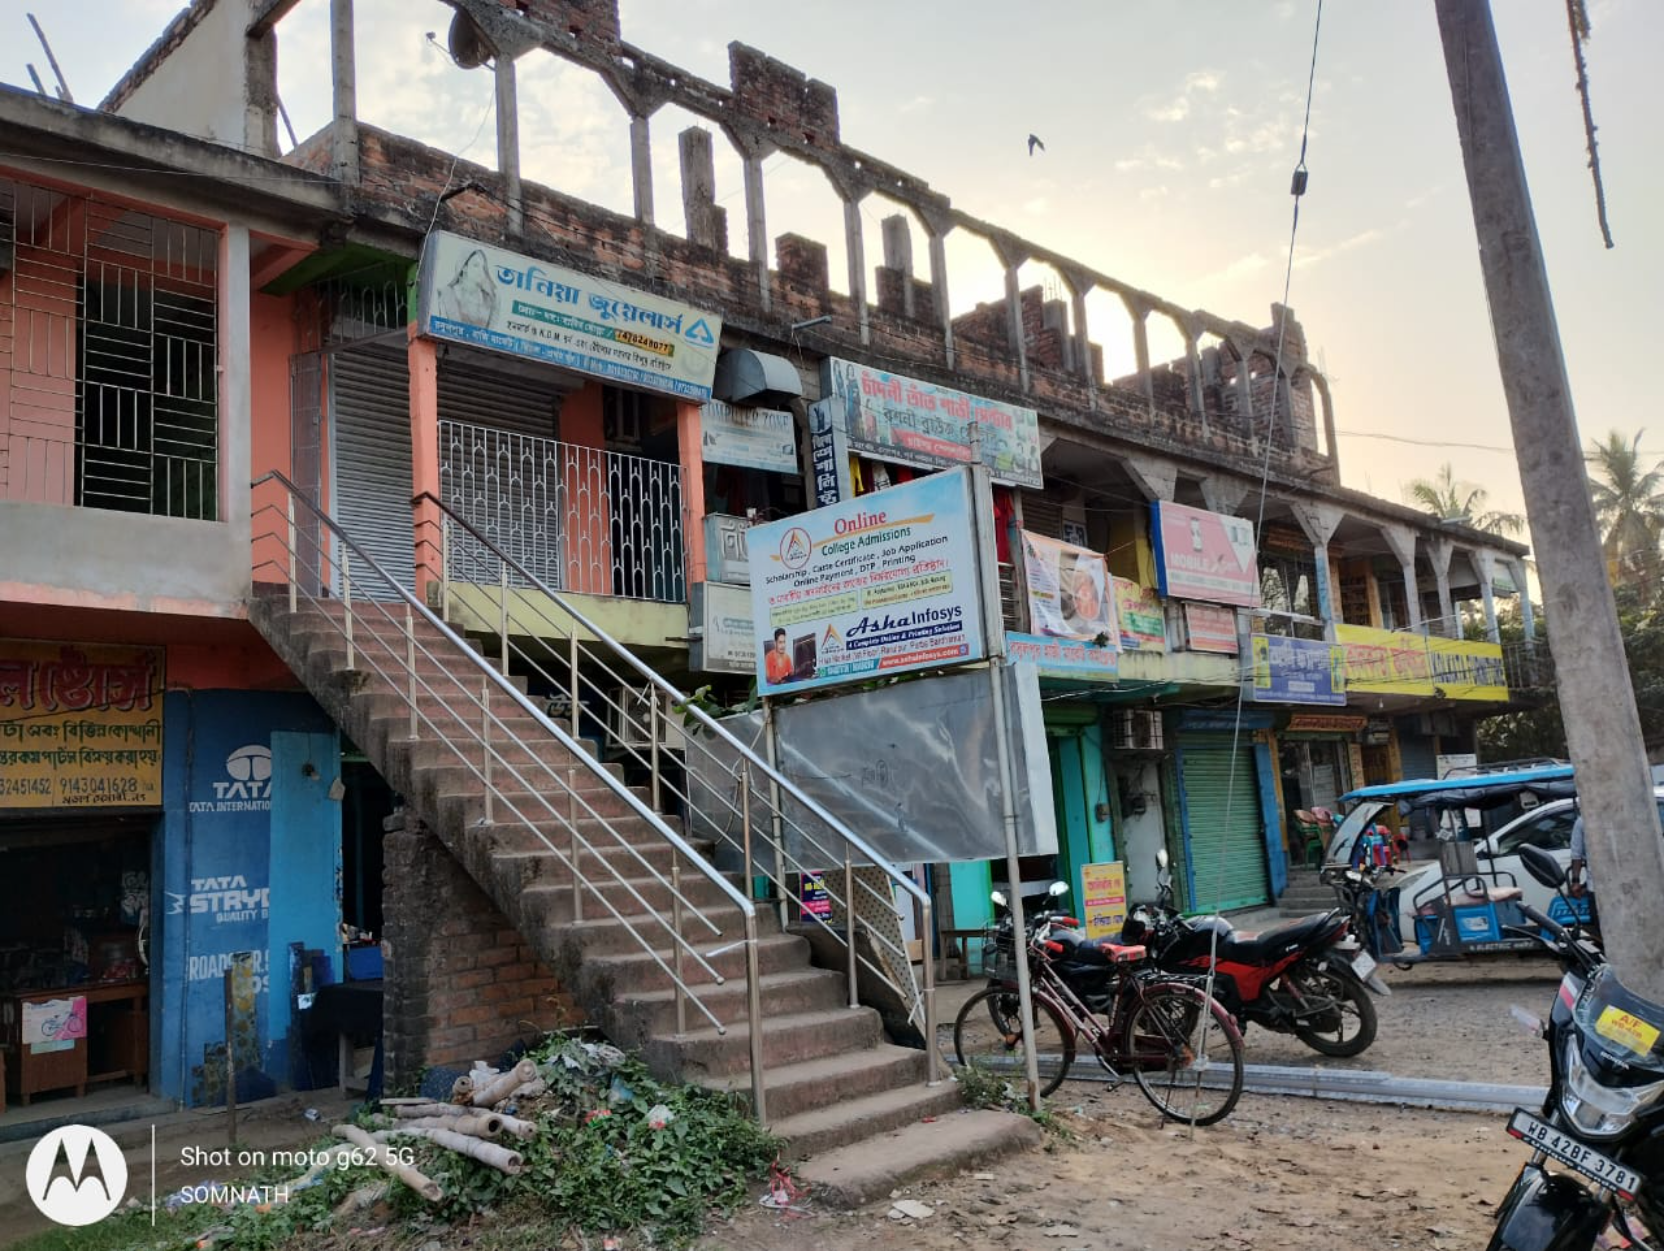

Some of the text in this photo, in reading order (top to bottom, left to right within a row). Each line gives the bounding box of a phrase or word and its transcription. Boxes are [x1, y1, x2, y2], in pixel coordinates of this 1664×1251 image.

[496, 265, 582, 305] তানিয়া
[834, 511, 887, 535] Online
[821, 540, 855, 556] College
[857, 527, 911, 549] Admissions
[765, 569, 807, 585] Scholarship
[835, 553, 875, 569] Certificate
[881, 547, 897, 558] Job
[898, 535, 948, 555] Application
[793, 554, 916, 588] Online Payment DTP Printing
[846, 605, 962, 637] Asha Infosys
[60, 777, 137, 795] 9143041628
[191, 875, 247, 891] TATA
[216, 910, 258, 923] QUALITY
[1620, 1013, 1643, 1029] A/F
[1599, 1050, 1630, 1071] HONDA
[1528, 1121, 1636, 1190] WB 42BF 3781
